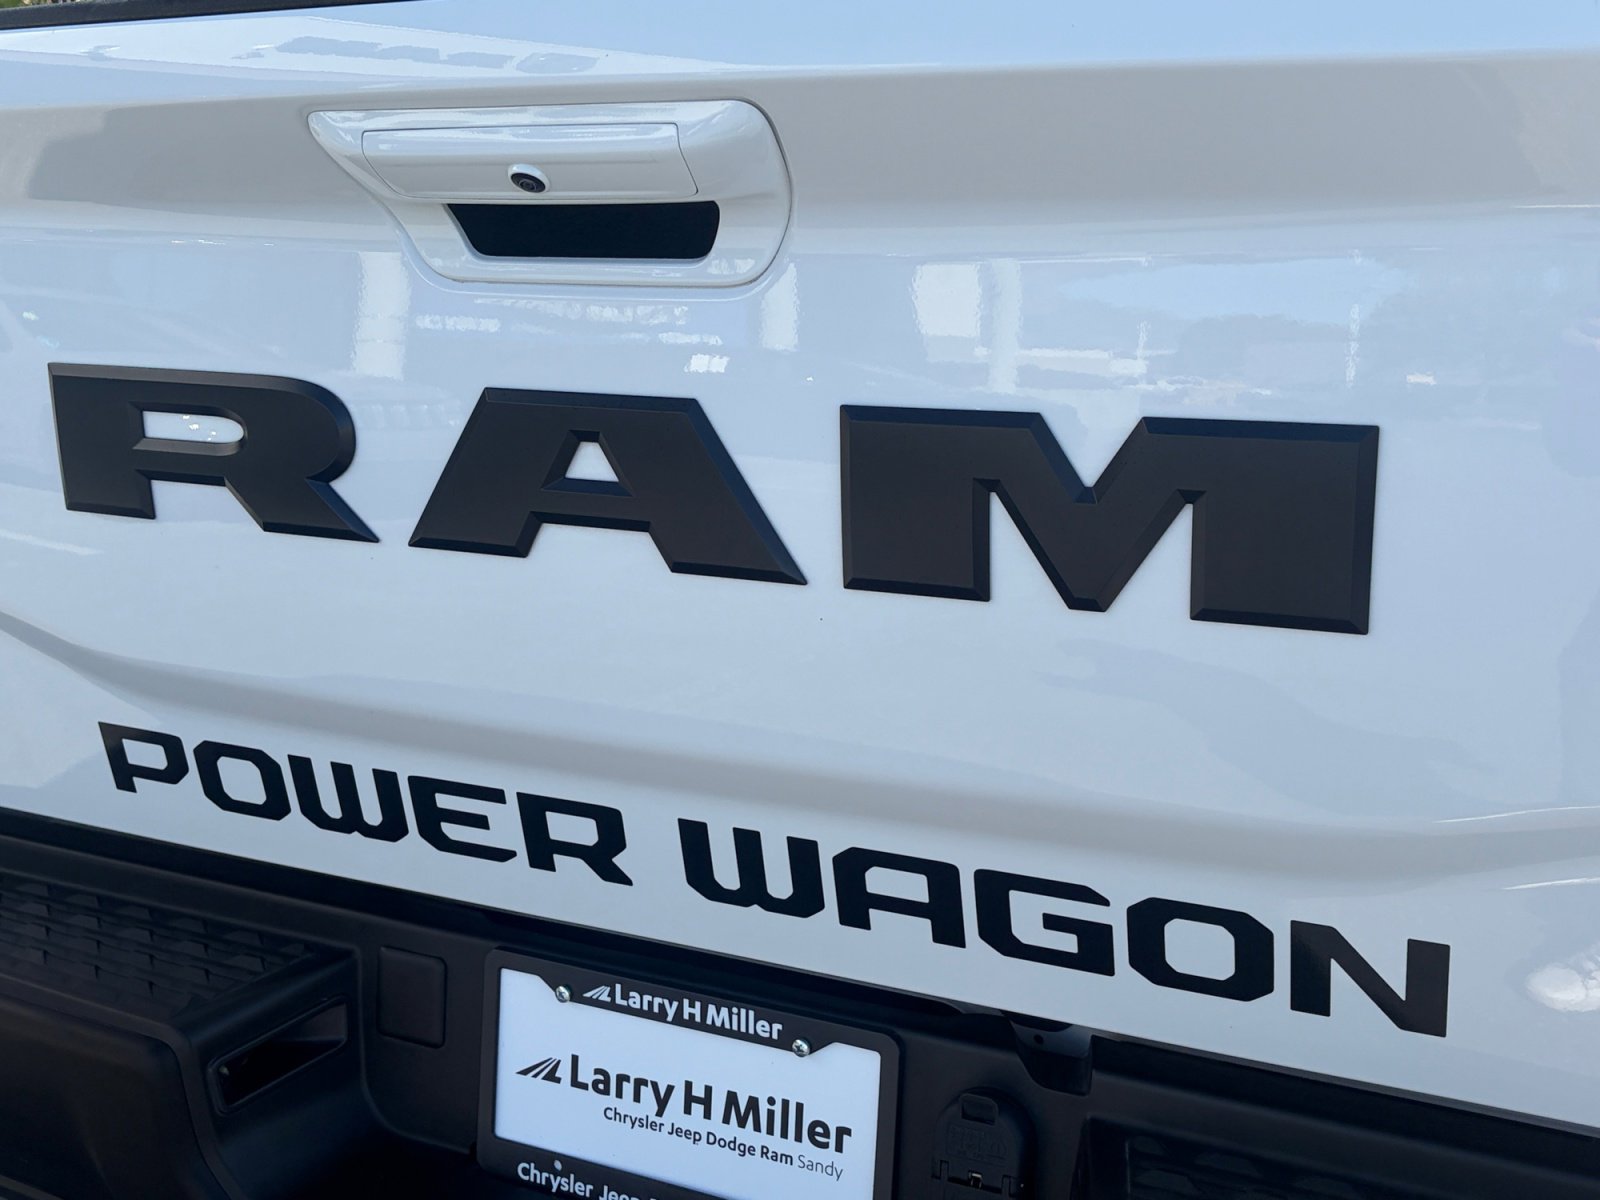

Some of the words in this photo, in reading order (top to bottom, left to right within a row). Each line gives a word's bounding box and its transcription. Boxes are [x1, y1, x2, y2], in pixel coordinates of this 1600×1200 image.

[48, 363, 1380, 636] RAM
[98, 722, 634, 887] POWER
[678, 818, 1450, 1038] WAGON
[615, 983, 679, 1022] Larry
[684, 998, 701, 1023] H
[705, 1003, 783, 1040] Miller
[570, 1053, 676, 1118] Larry
[683, 1079, 713, 1121] H
[721, 1089, 852, 1154] Miller
[603, 1106, 665, 1134] Chrysler
[667, 1122, 702, 1145] Jeep
[706, 1131, 756, 1158] Dodge
[760, 1144, 794, 1166] Ram
[798, 1154, 844, 1181] Sandy
[517, 1161, 594, 1198] Chrysler
[598, 1184, 640, 1200] Je
